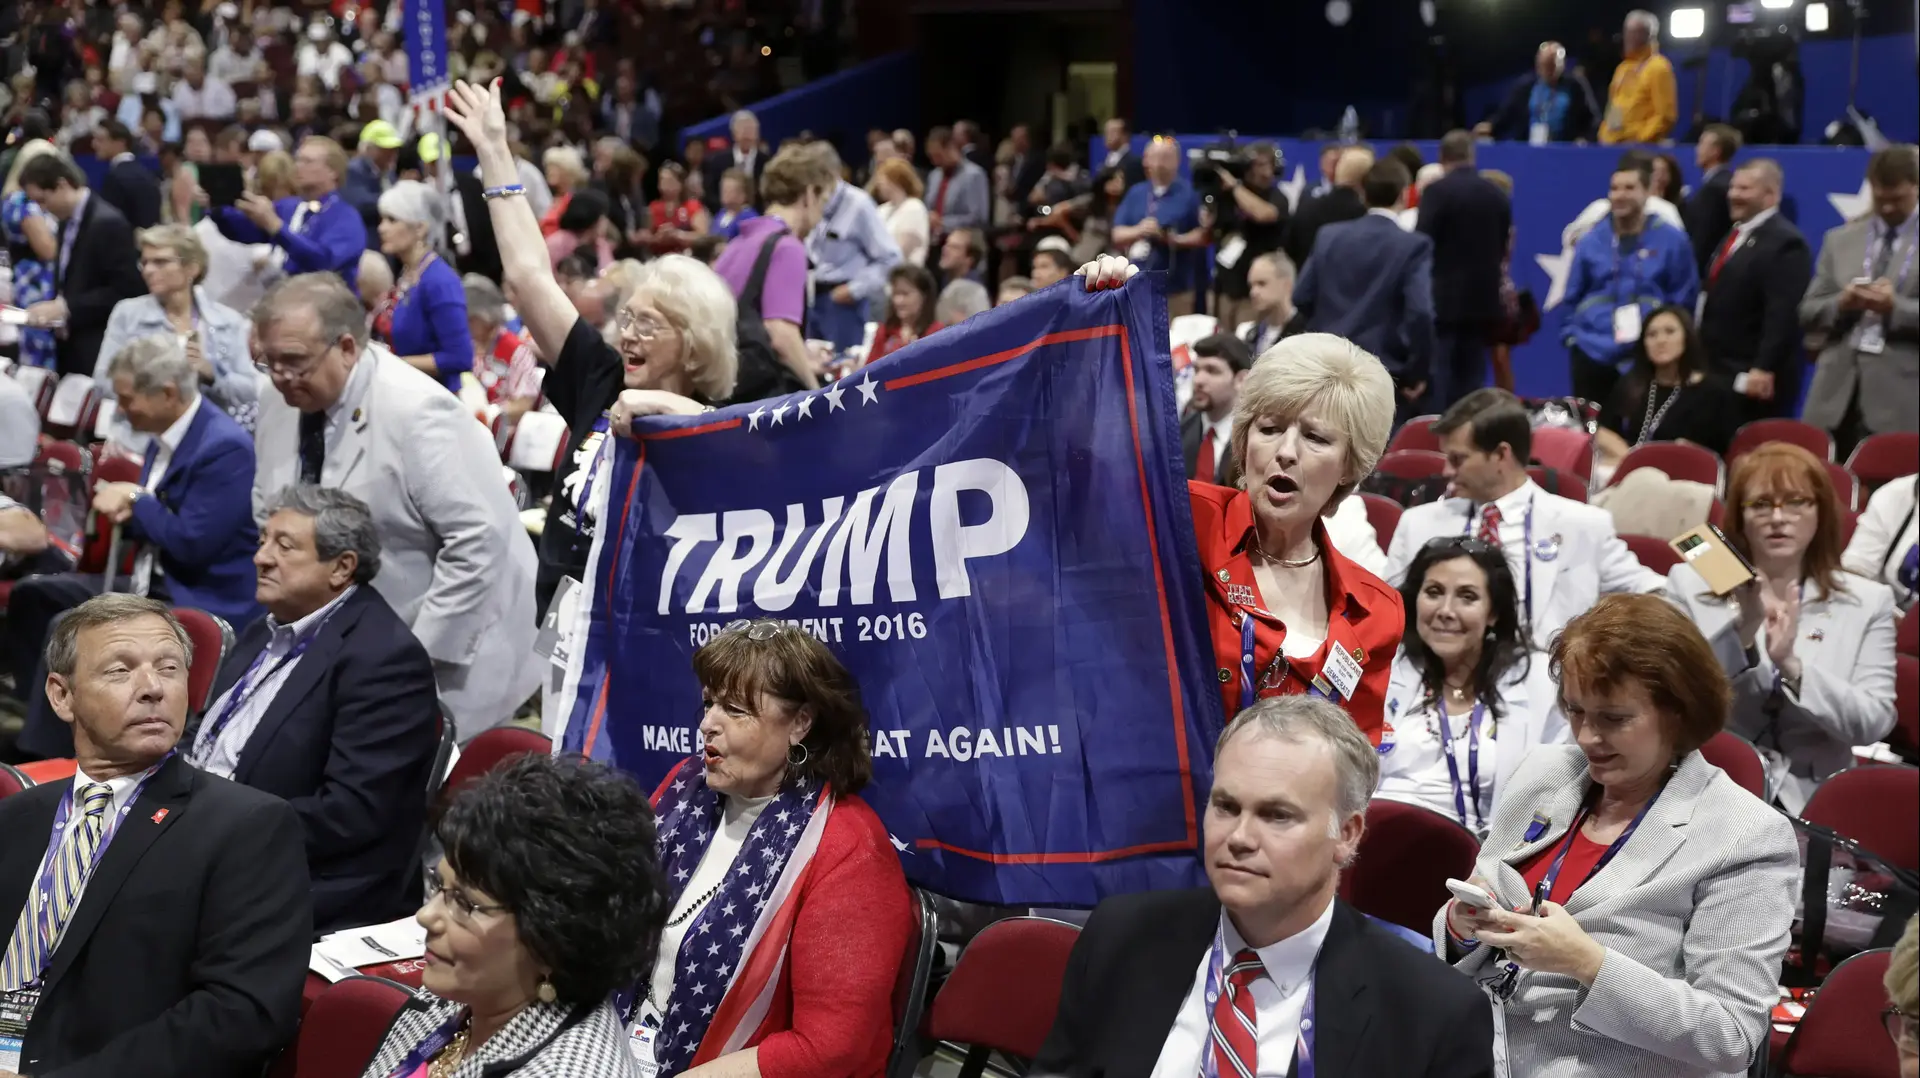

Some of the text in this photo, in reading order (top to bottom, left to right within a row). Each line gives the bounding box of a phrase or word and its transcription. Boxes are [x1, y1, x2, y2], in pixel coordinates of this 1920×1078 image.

[658, 458, 1030, 615] TRUMP
[857, 612, 927, 641] 2016
[1334, 644, 1362, 677] REPUBLICANS
[1325, 666, 1351, 696] DEMOCRATS
[642, 725, 691, 753] MAKE
[925, 724, 1062, 762] AGAIN!
